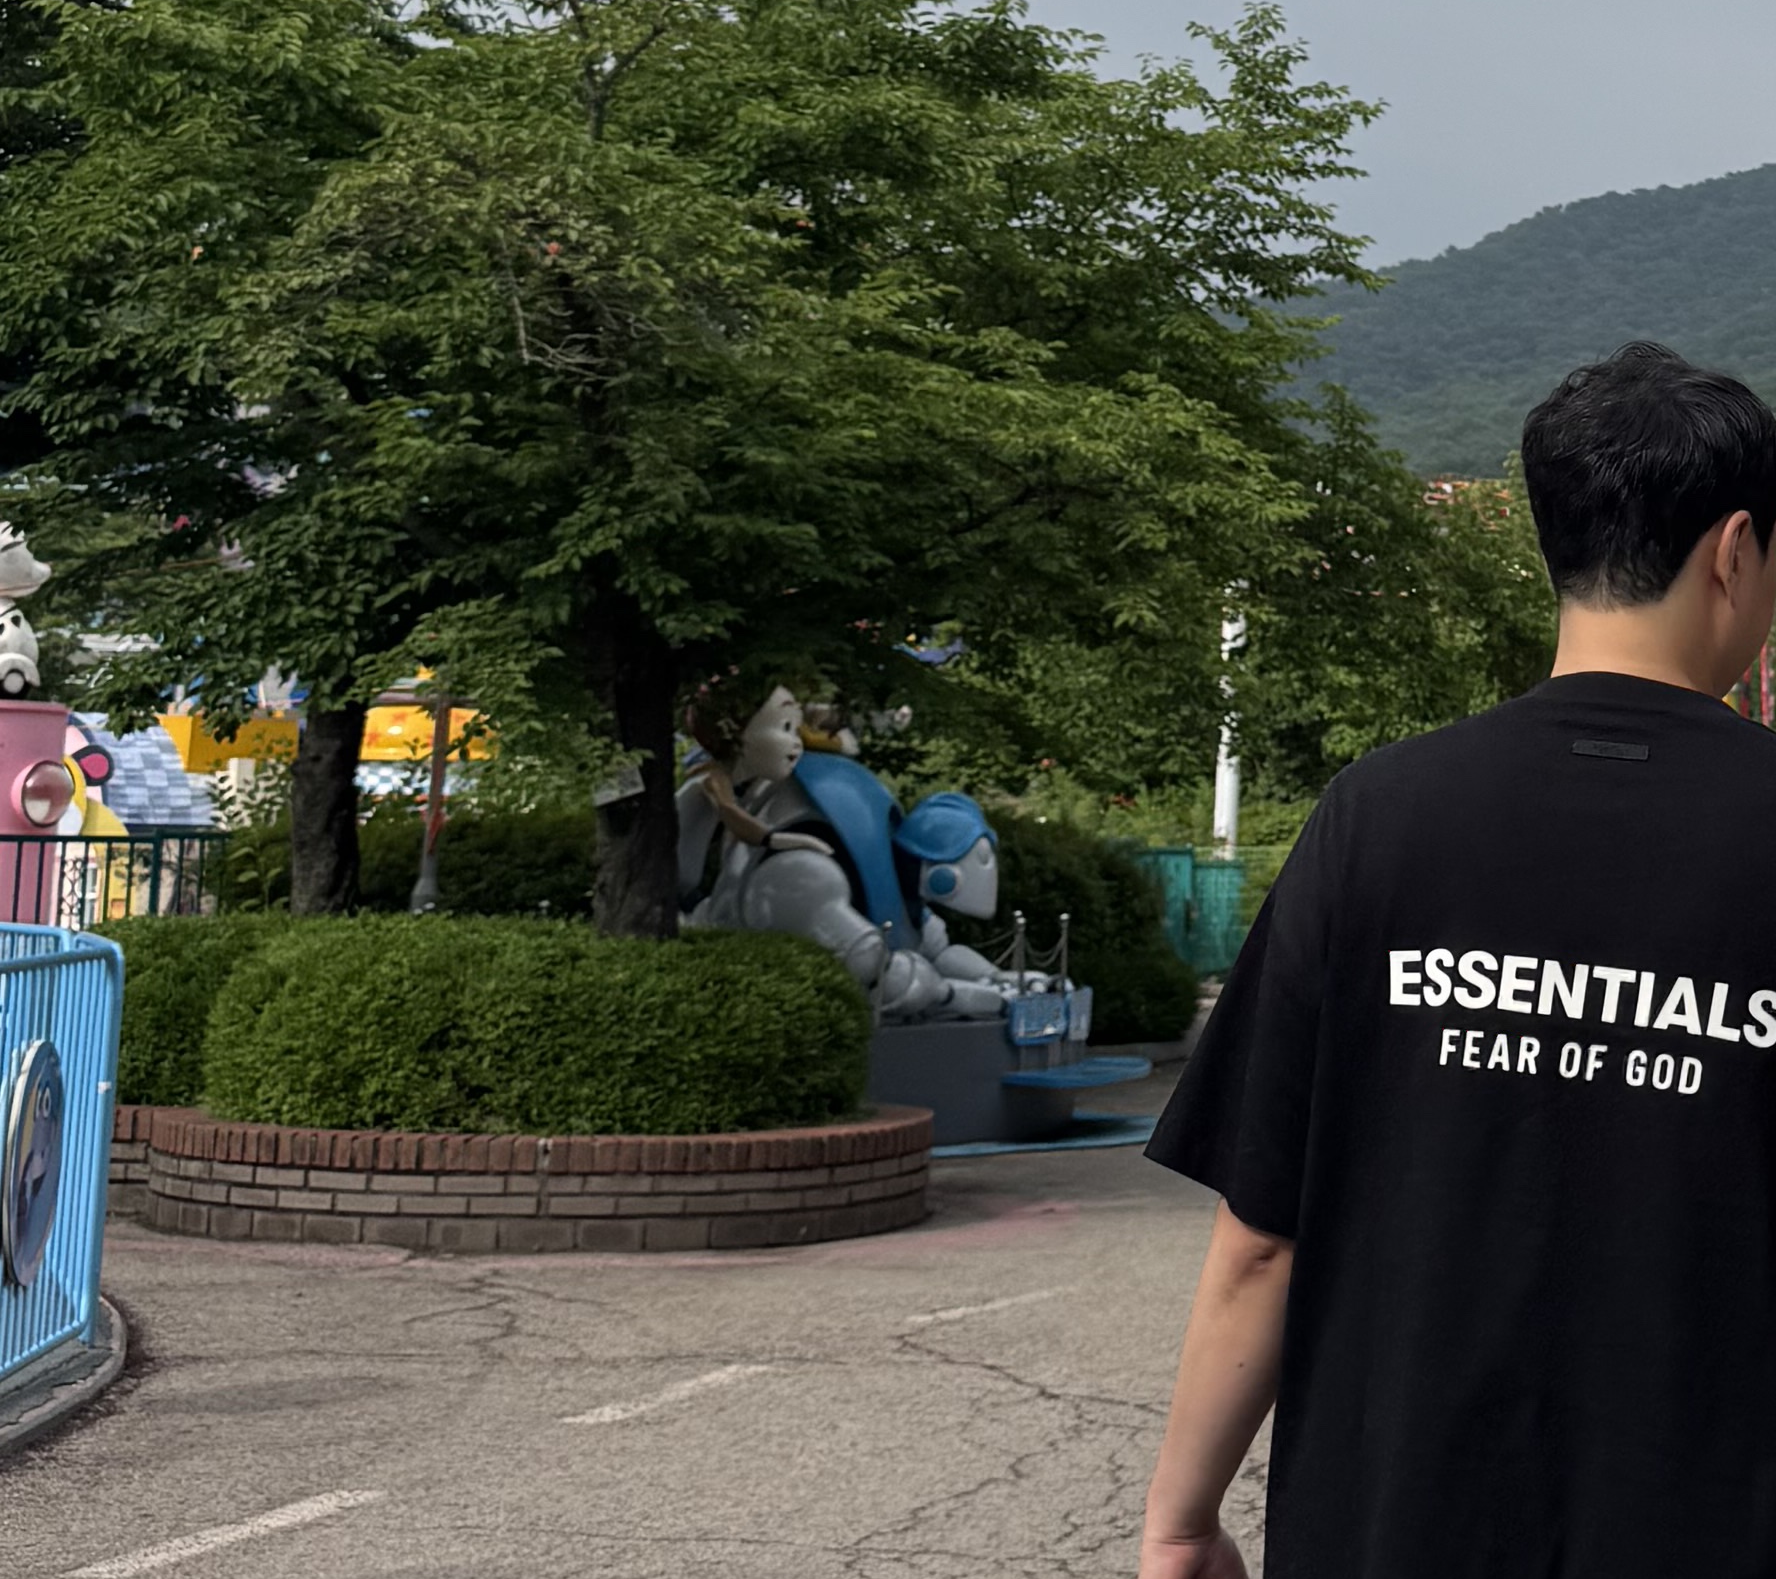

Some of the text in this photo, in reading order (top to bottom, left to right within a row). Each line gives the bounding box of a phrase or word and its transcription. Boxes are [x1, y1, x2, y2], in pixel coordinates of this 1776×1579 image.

[1439, 1028, 1703, 1095] FEAR OF GOD
